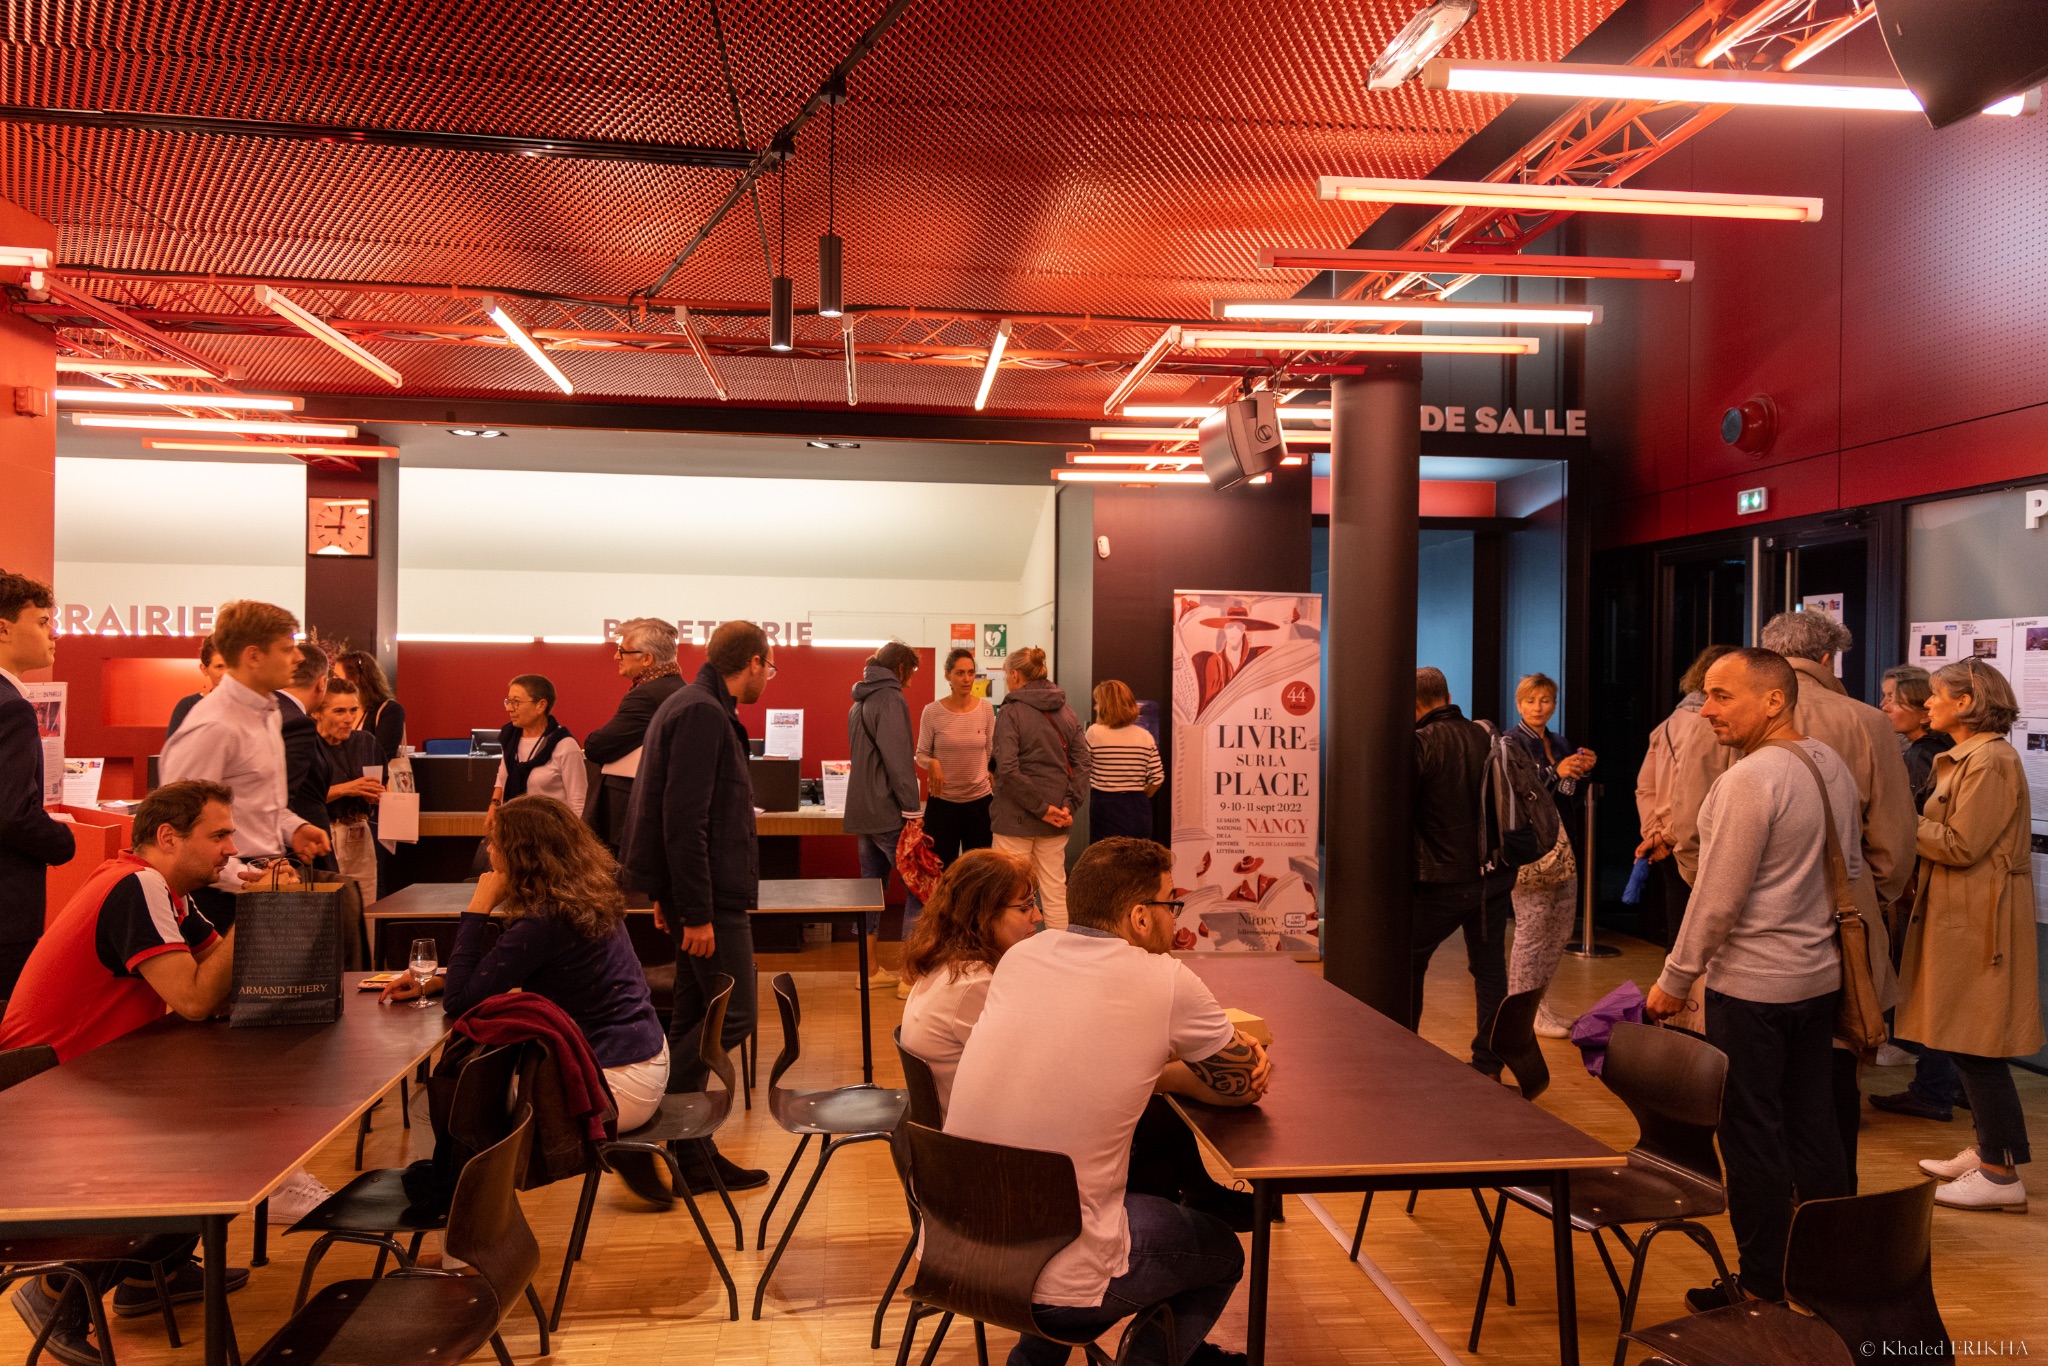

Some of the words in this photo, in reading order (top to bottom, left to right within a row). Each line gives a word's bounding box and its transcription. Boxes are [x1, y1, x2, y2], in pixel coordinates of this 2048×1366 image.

[1420, 405, 1466, 432] DE
[1474, 406, 1587, 437] SALLE
[603, 618, 813, 646] BETRIE
[984, 648, 1006, 657] DAE
[1253, 707, 1273, 720] LE
[1216, 724, 1307, 750] LIVRE
[1236, 754, 1265, 767] SUR
[1268, 754, 1287, 767] LA
[1213, 771, 1309, 797] PLACE
[1256, 804, 1276, 814] sept
[1277, 803, 1302, 813] 2022
[1245, 818, 1309, 834] NANCY
[239, 985, 285, 995] ARMAND
[286, 983, 328, 994] THIERY
